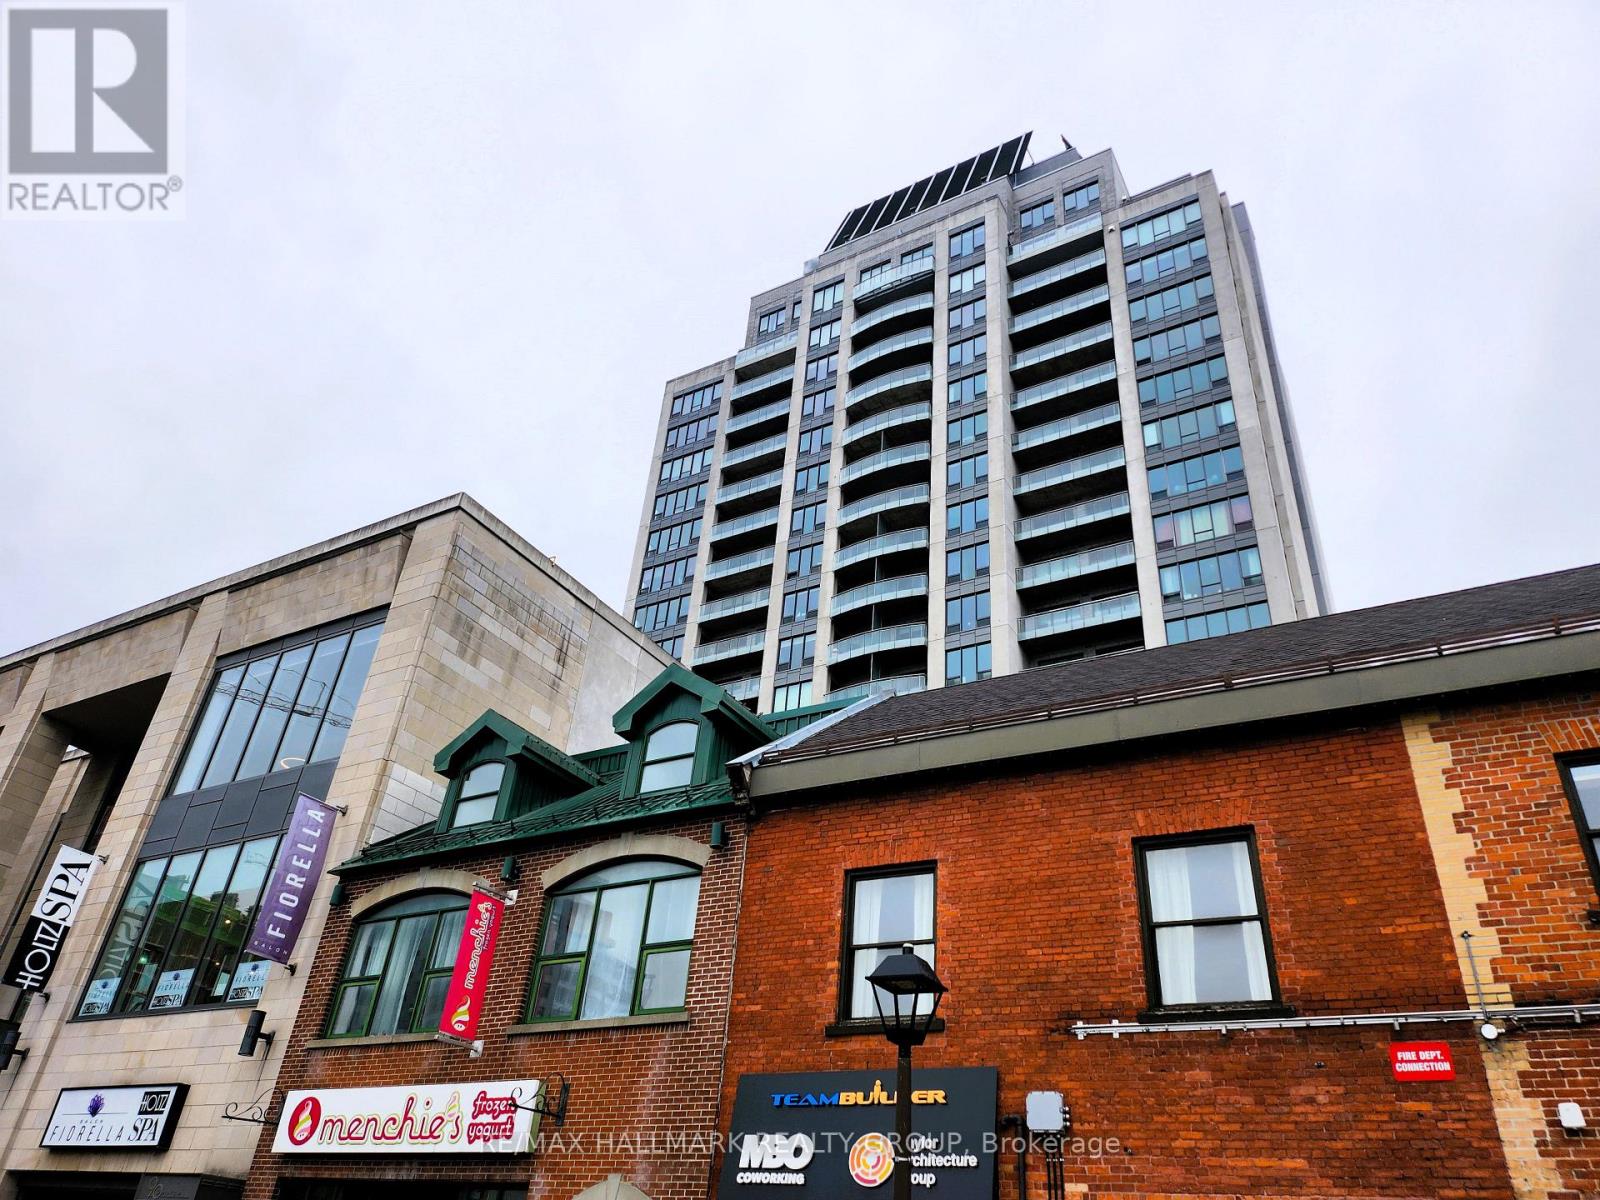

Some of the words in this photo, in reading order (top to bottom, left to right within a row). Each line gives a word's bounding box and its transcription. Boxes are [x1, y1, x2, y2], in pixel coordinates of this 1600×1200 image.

[267, 809, 326, 939] FIORELLA
[254, 940, 288, 955] SALON
[464, 901, 493, 990] menchie's
[1397, 1051, 1417, 1060] FIRE
[1419, 1050, 1444, 1060] DEPT.
[1395, 1061, 1451, 1072] CONNECTION
[139, 1093, 170, 1112] HOLTZ
[771, 1080, 947, 1106] TEAMBUILER
[128, 1117, 160, 1141] SPA
[318, 1092, 463, 1146] menchie's
[468, 1116, 513, 1142] yogurt
[50, 1125, 125, 1142] FIORELLA
[736, 1171, 805, 1185] COWORKING
